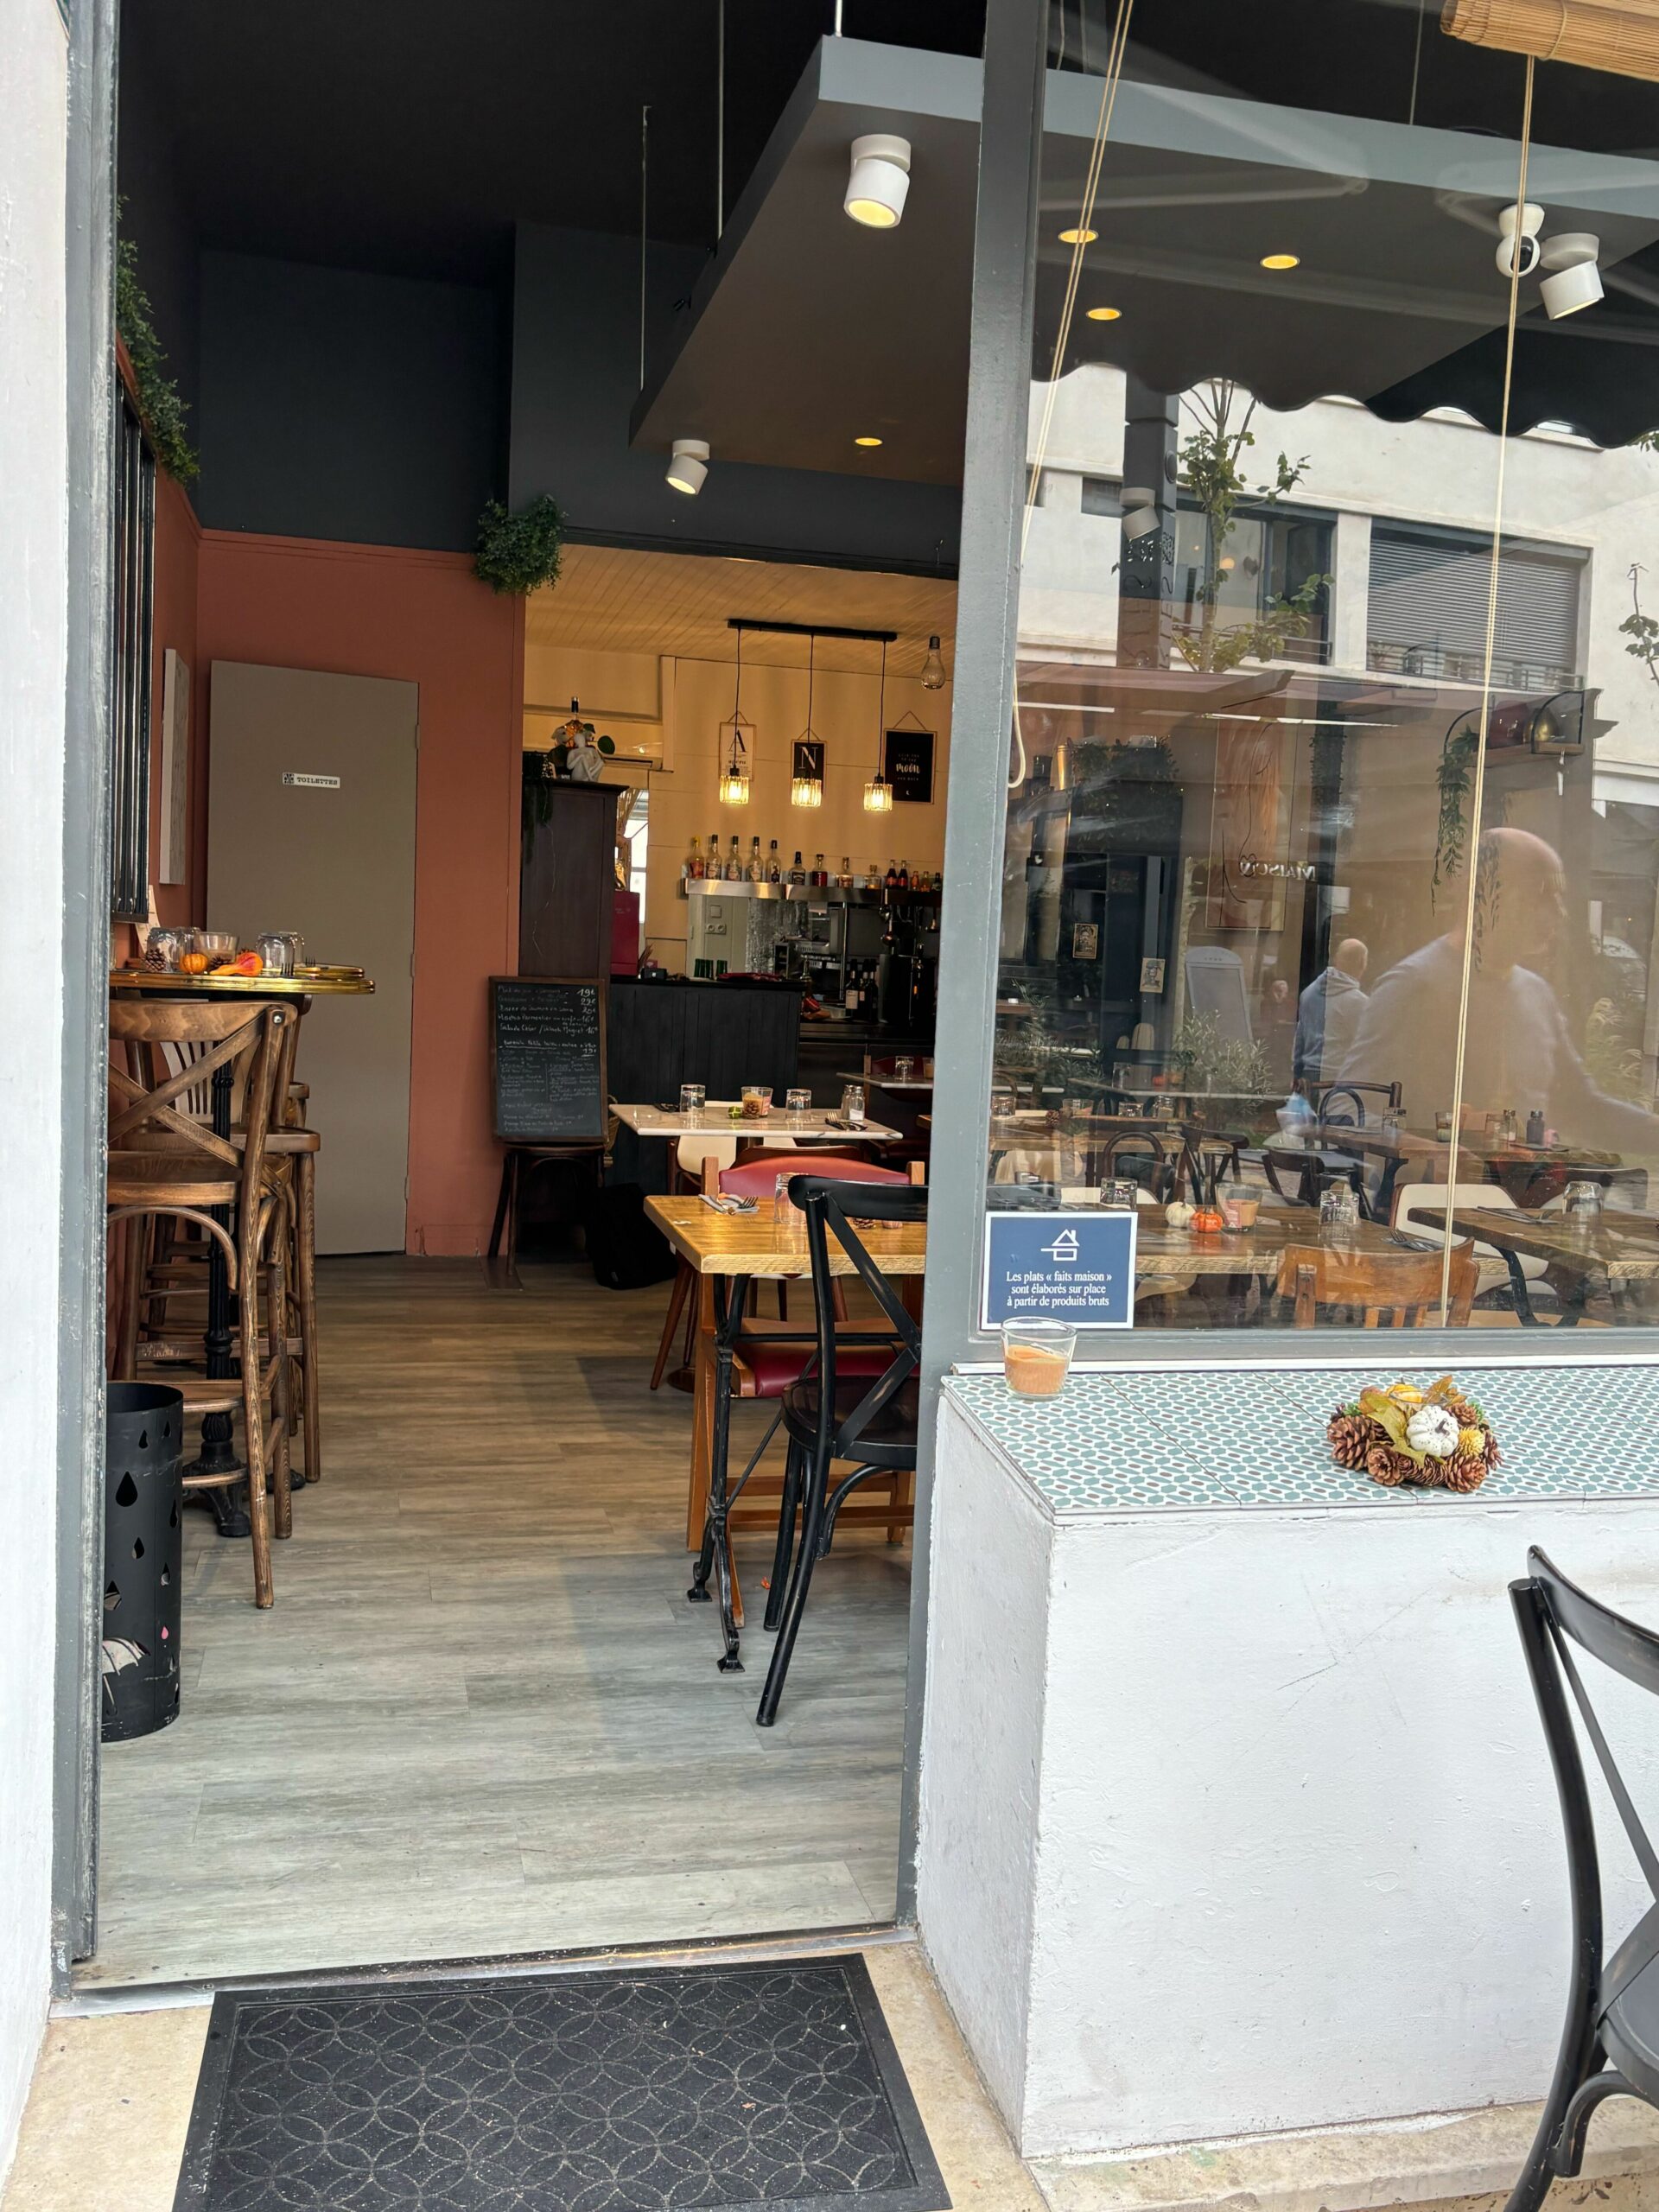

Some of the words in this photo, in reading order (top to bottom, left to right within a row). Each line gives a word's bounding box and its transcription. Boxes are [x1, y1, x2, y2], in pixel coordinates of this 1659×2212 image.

[799, 747, 818, 770] N
[896, 763, 920, 774] moon
[296, 777, 338, 785] TOILETTES
[1006, 1271, 1022, 1282] Les
[1023, 1271, 1044, 1284] plats
[1054, 1271, 1072, 1281] faits
[1074, 1272, 1104, 1281] maison
[1011, 1284, 1029, 1294] sont
[1031, 1283, 1066, 1294] élaborés
[1084, 1283, 1106, 1296] place
[1007, 1296, 1013, 1306] à
[1014, 1296, 1037, 1308] partir
[1039, 1295, 1050, 1306] de
[1052, 1295, 1086, 1308] produits
[1088, 1295, 1109, 1306] bruts
